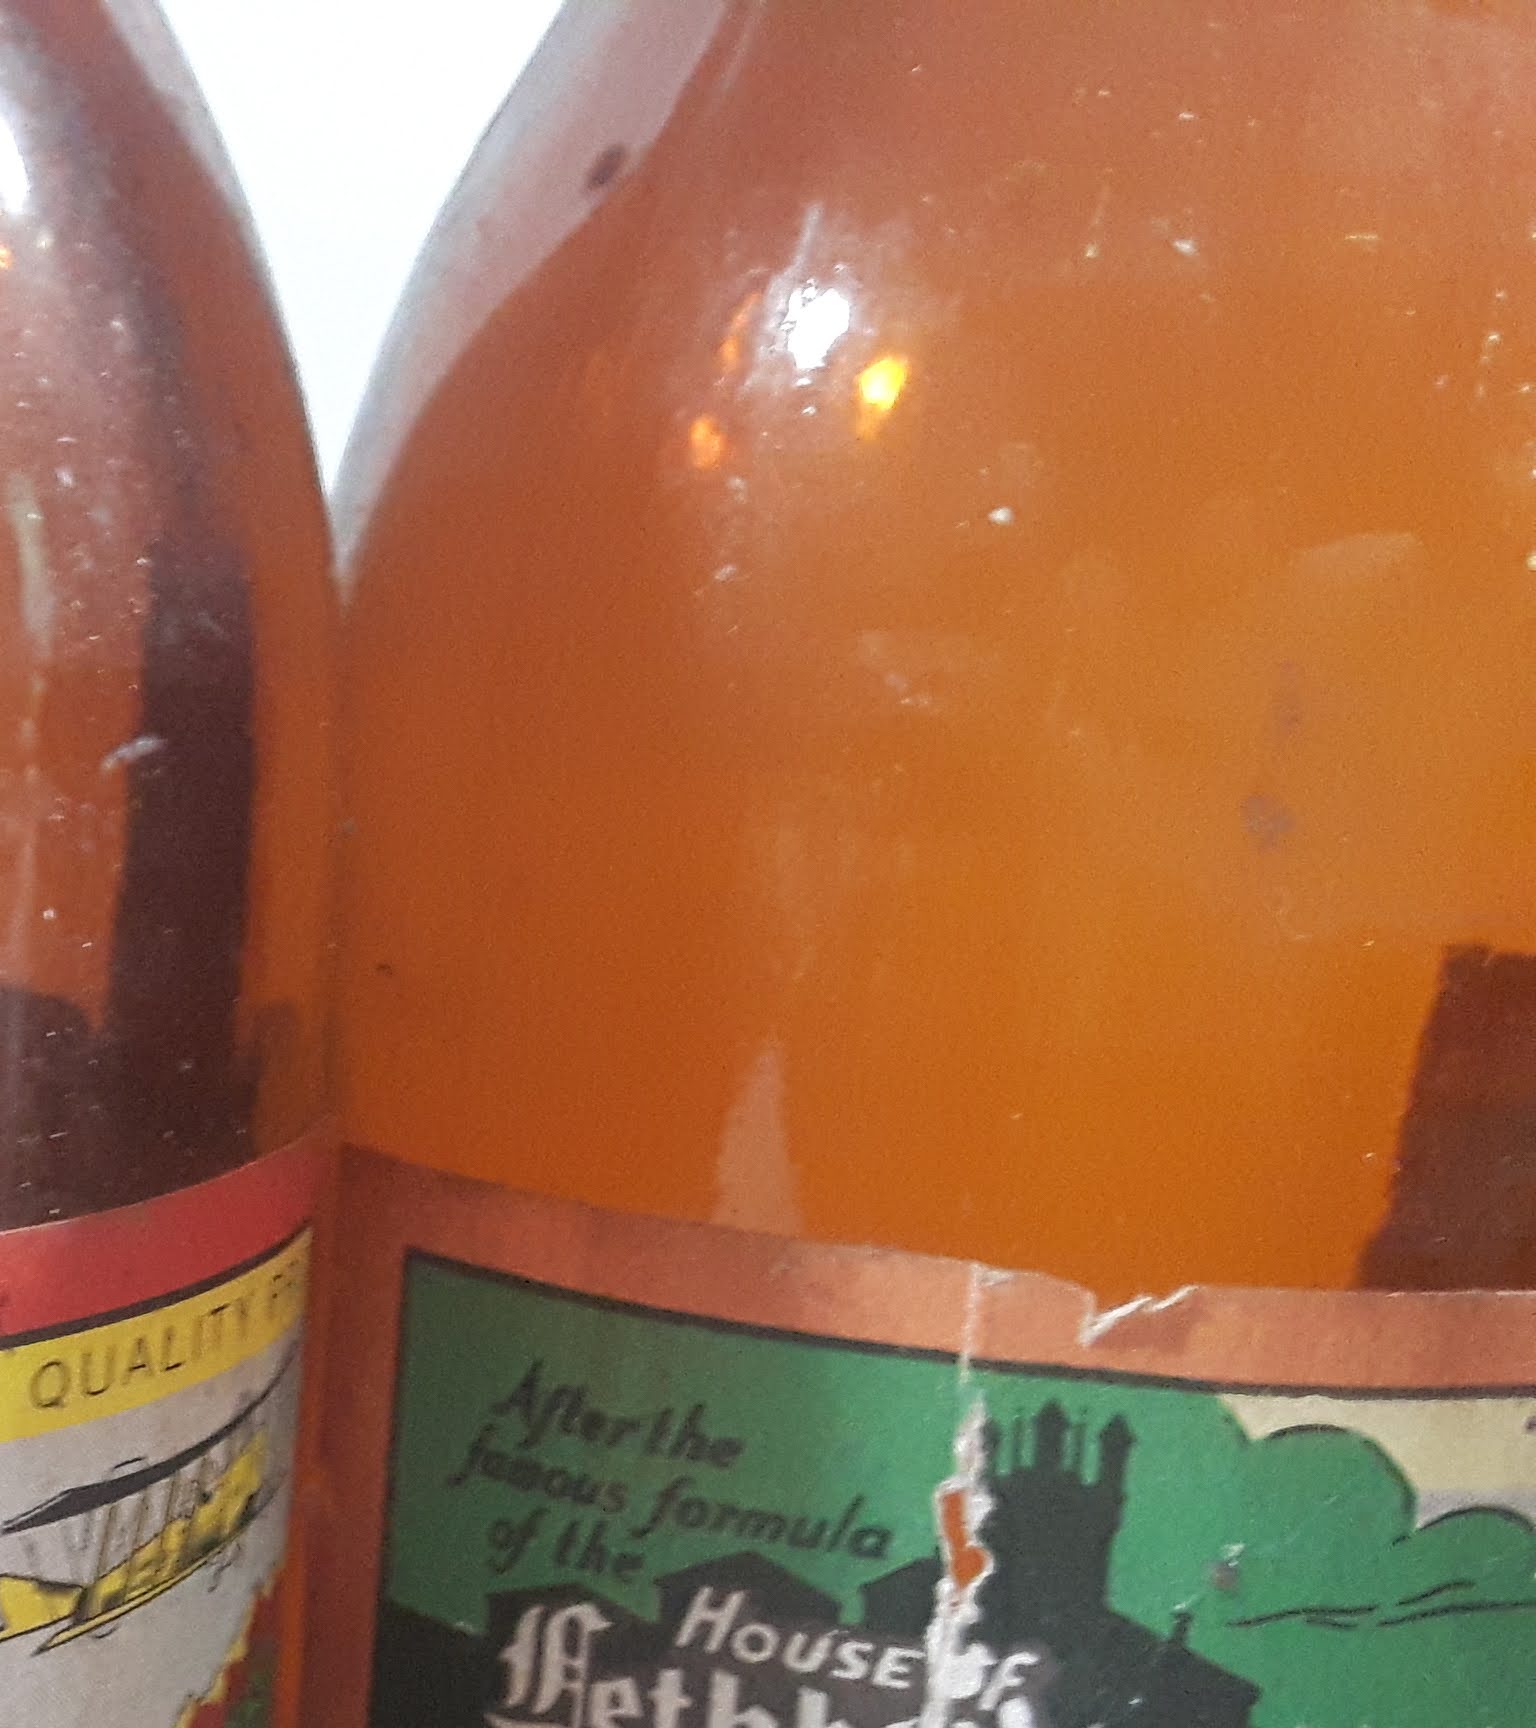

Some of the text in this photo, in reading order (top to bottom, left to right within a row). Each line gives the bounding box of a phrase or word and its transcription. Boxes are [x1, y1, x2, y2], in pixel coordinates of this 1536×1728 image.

[28, 1289, 254, 1410] QUALITY
[490, 1359, 745, 1468] After the
[446, 1422, 895, 1561] famous formula
[487, 1507, 645, 1580] of the
